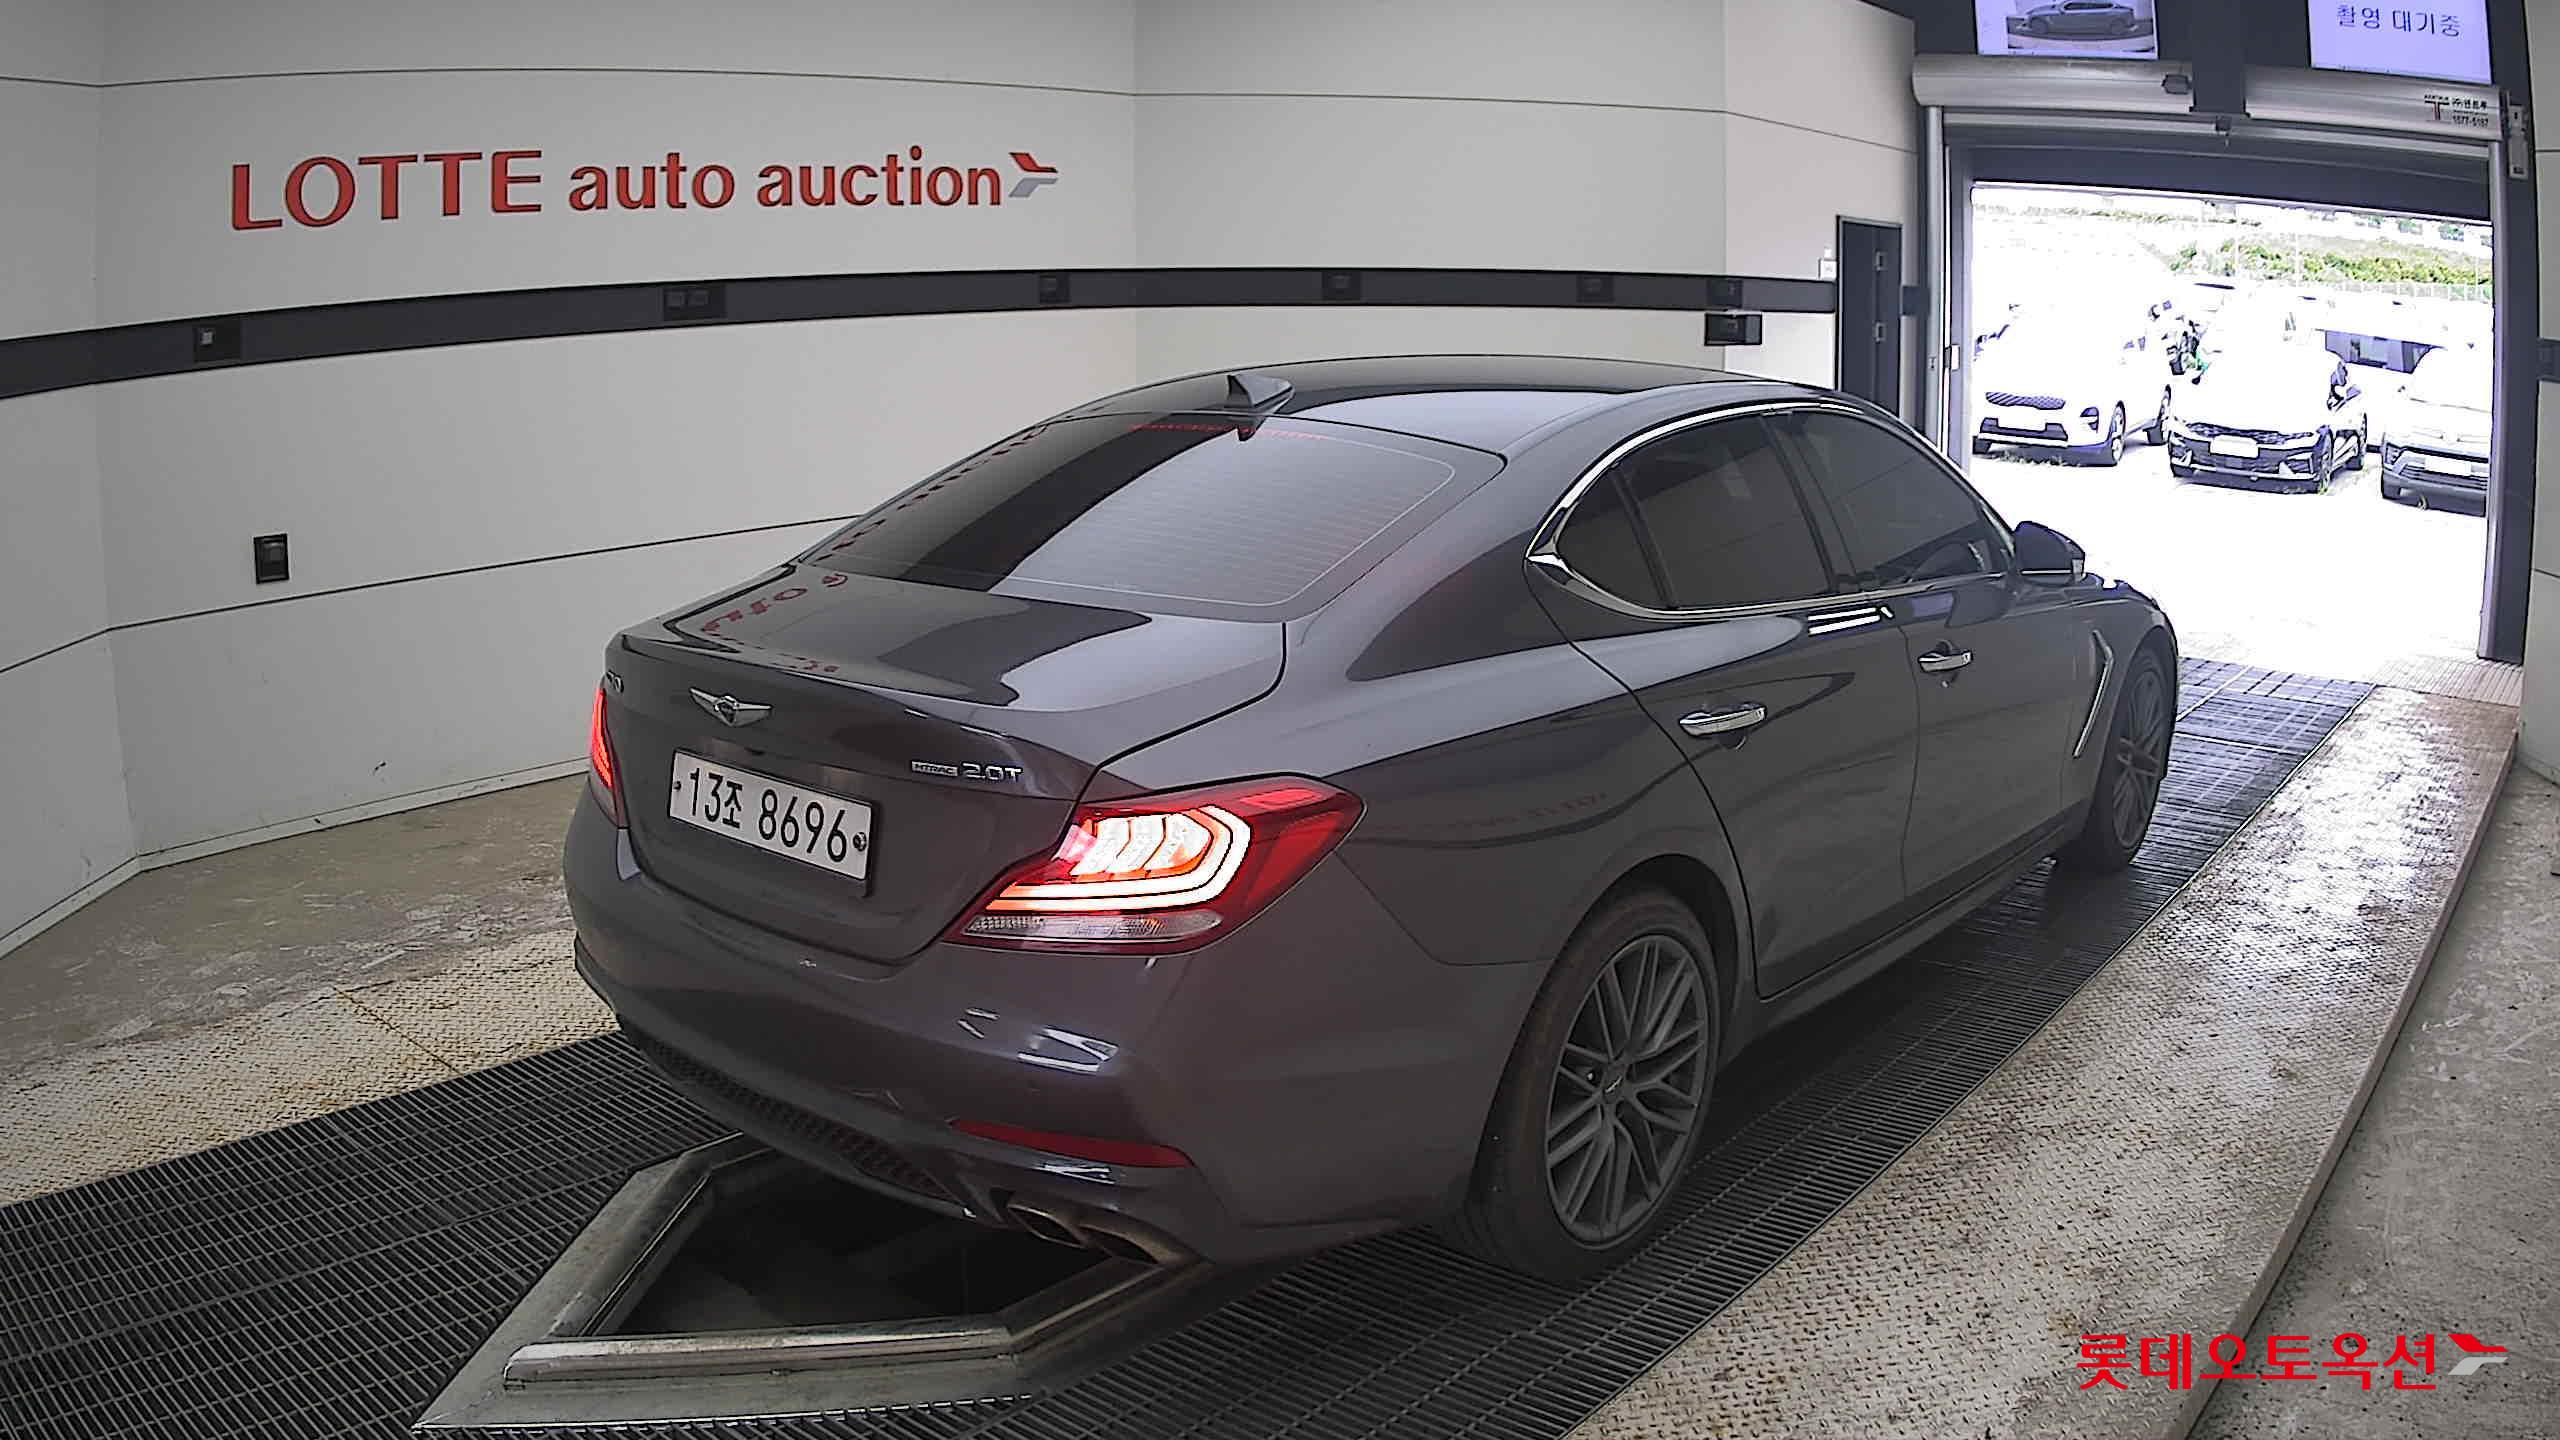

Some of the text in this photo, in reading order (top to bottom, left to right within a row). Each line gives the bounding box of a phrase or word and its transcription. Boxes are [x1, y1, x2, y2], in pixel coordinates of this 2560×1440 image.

[2337, 5, 2460, 37] 촬영 대기중
[232, 146, 1002, 231] LOTTE auto auction
[962, 762, 1023, 782] 2.0T
[689, 767, 848, 863] 13조 8696
